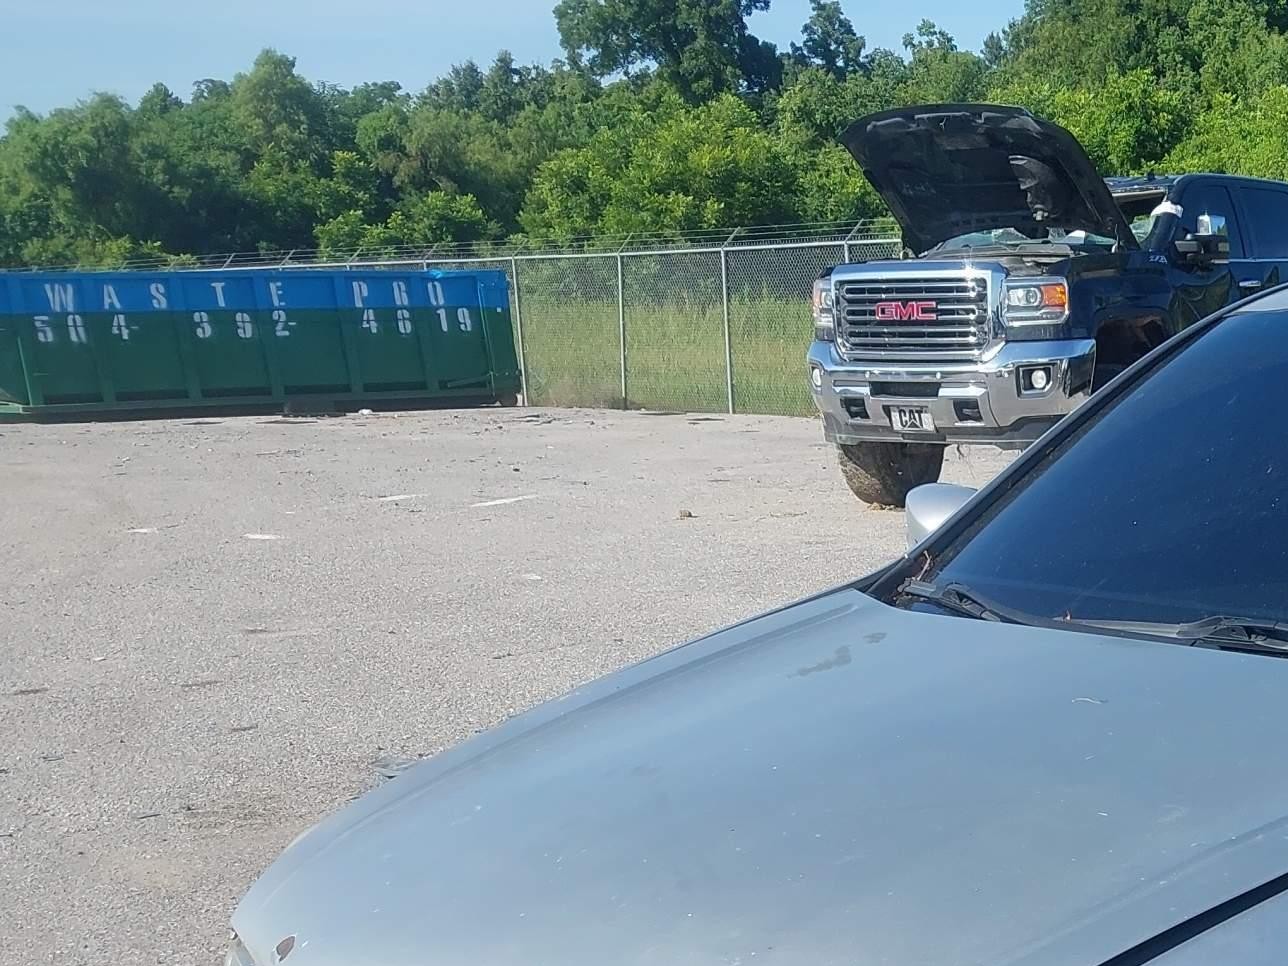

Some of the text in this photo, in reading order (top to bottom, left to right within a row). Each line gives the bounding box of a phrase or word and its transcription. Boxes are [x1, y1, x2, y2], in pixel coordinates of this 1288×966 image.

[44, 282, 284, 313] WASTE
[876, 301, 937, 320] GMC
[899, 408, 924, 429] CAT
